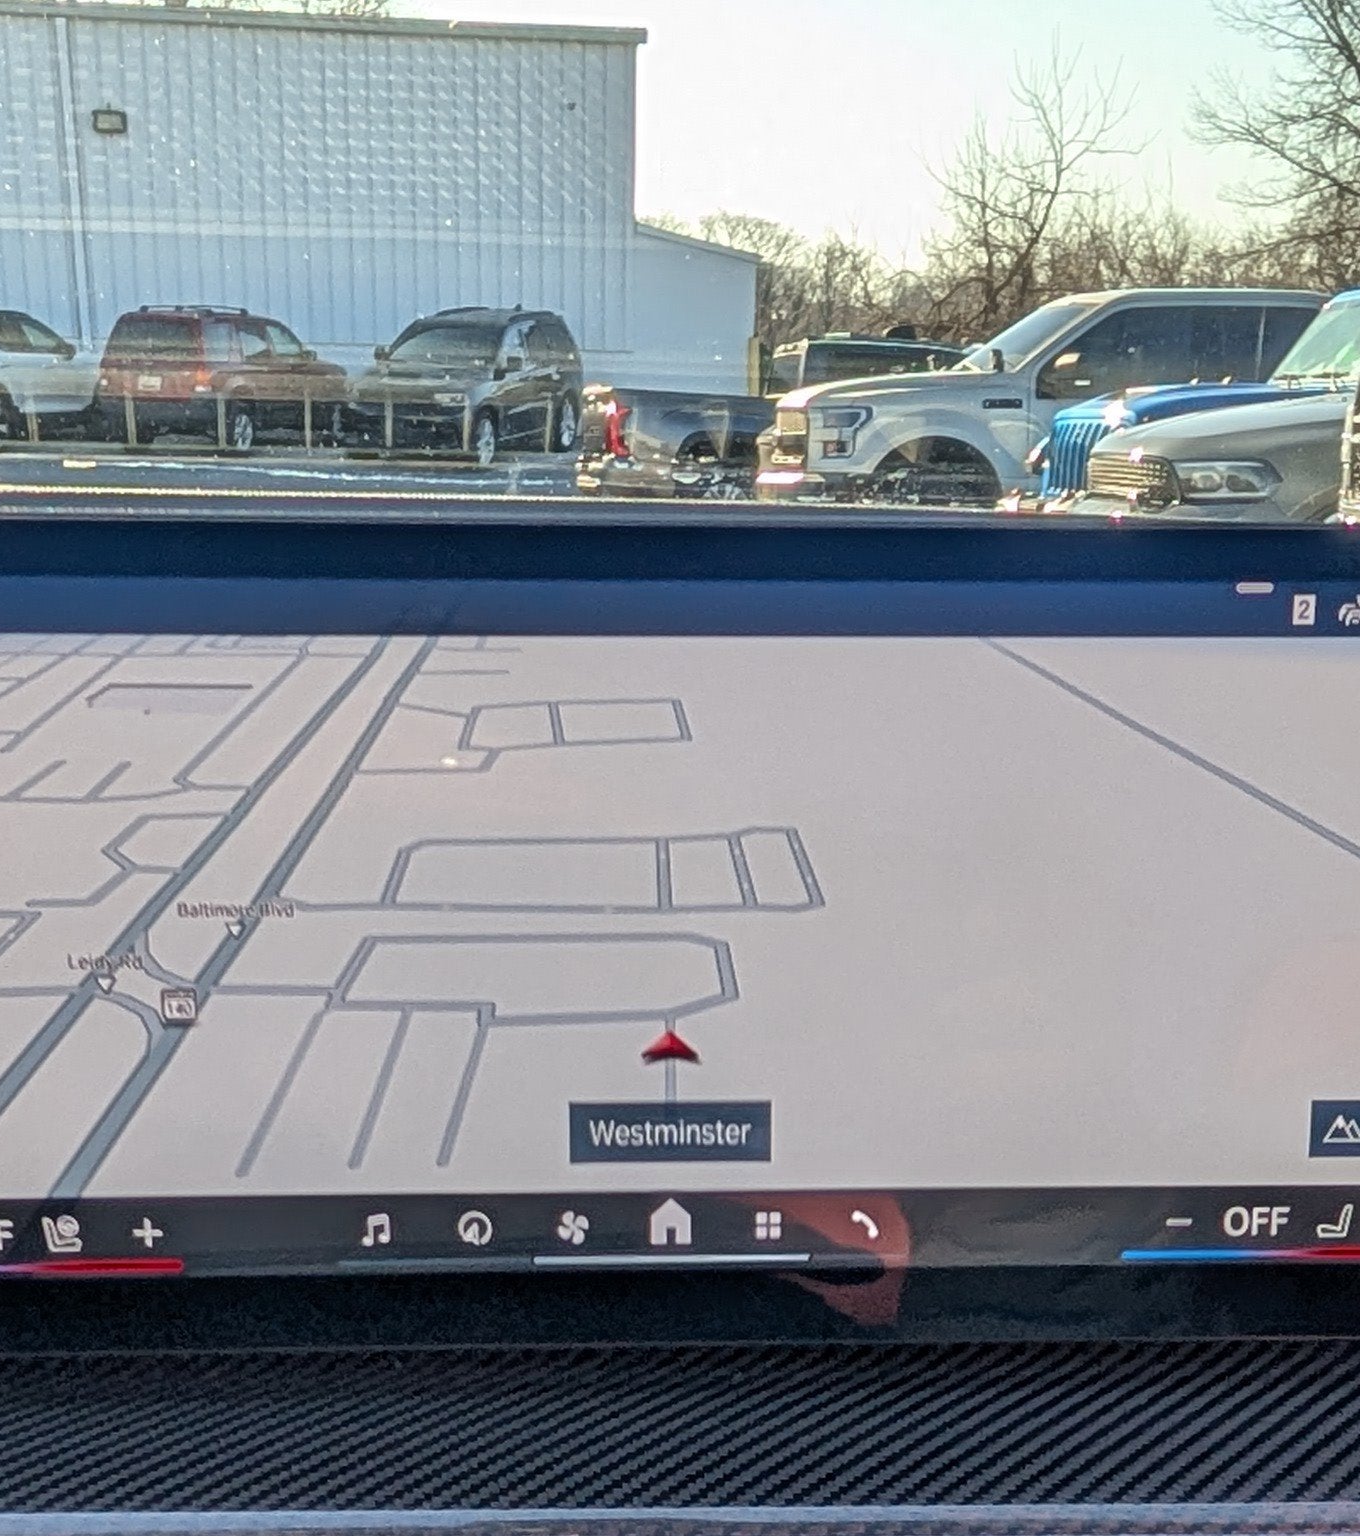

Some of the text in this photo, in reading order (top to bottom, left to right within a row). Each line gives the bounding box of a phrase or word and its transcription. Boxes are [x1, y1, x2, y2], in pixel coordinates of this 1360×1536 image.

[176, 902, 296, 919] Baltimore Blvd
[589, 1119, 752, 1147] Westminster
[1222, 1206, 1291, 1236] OFF
